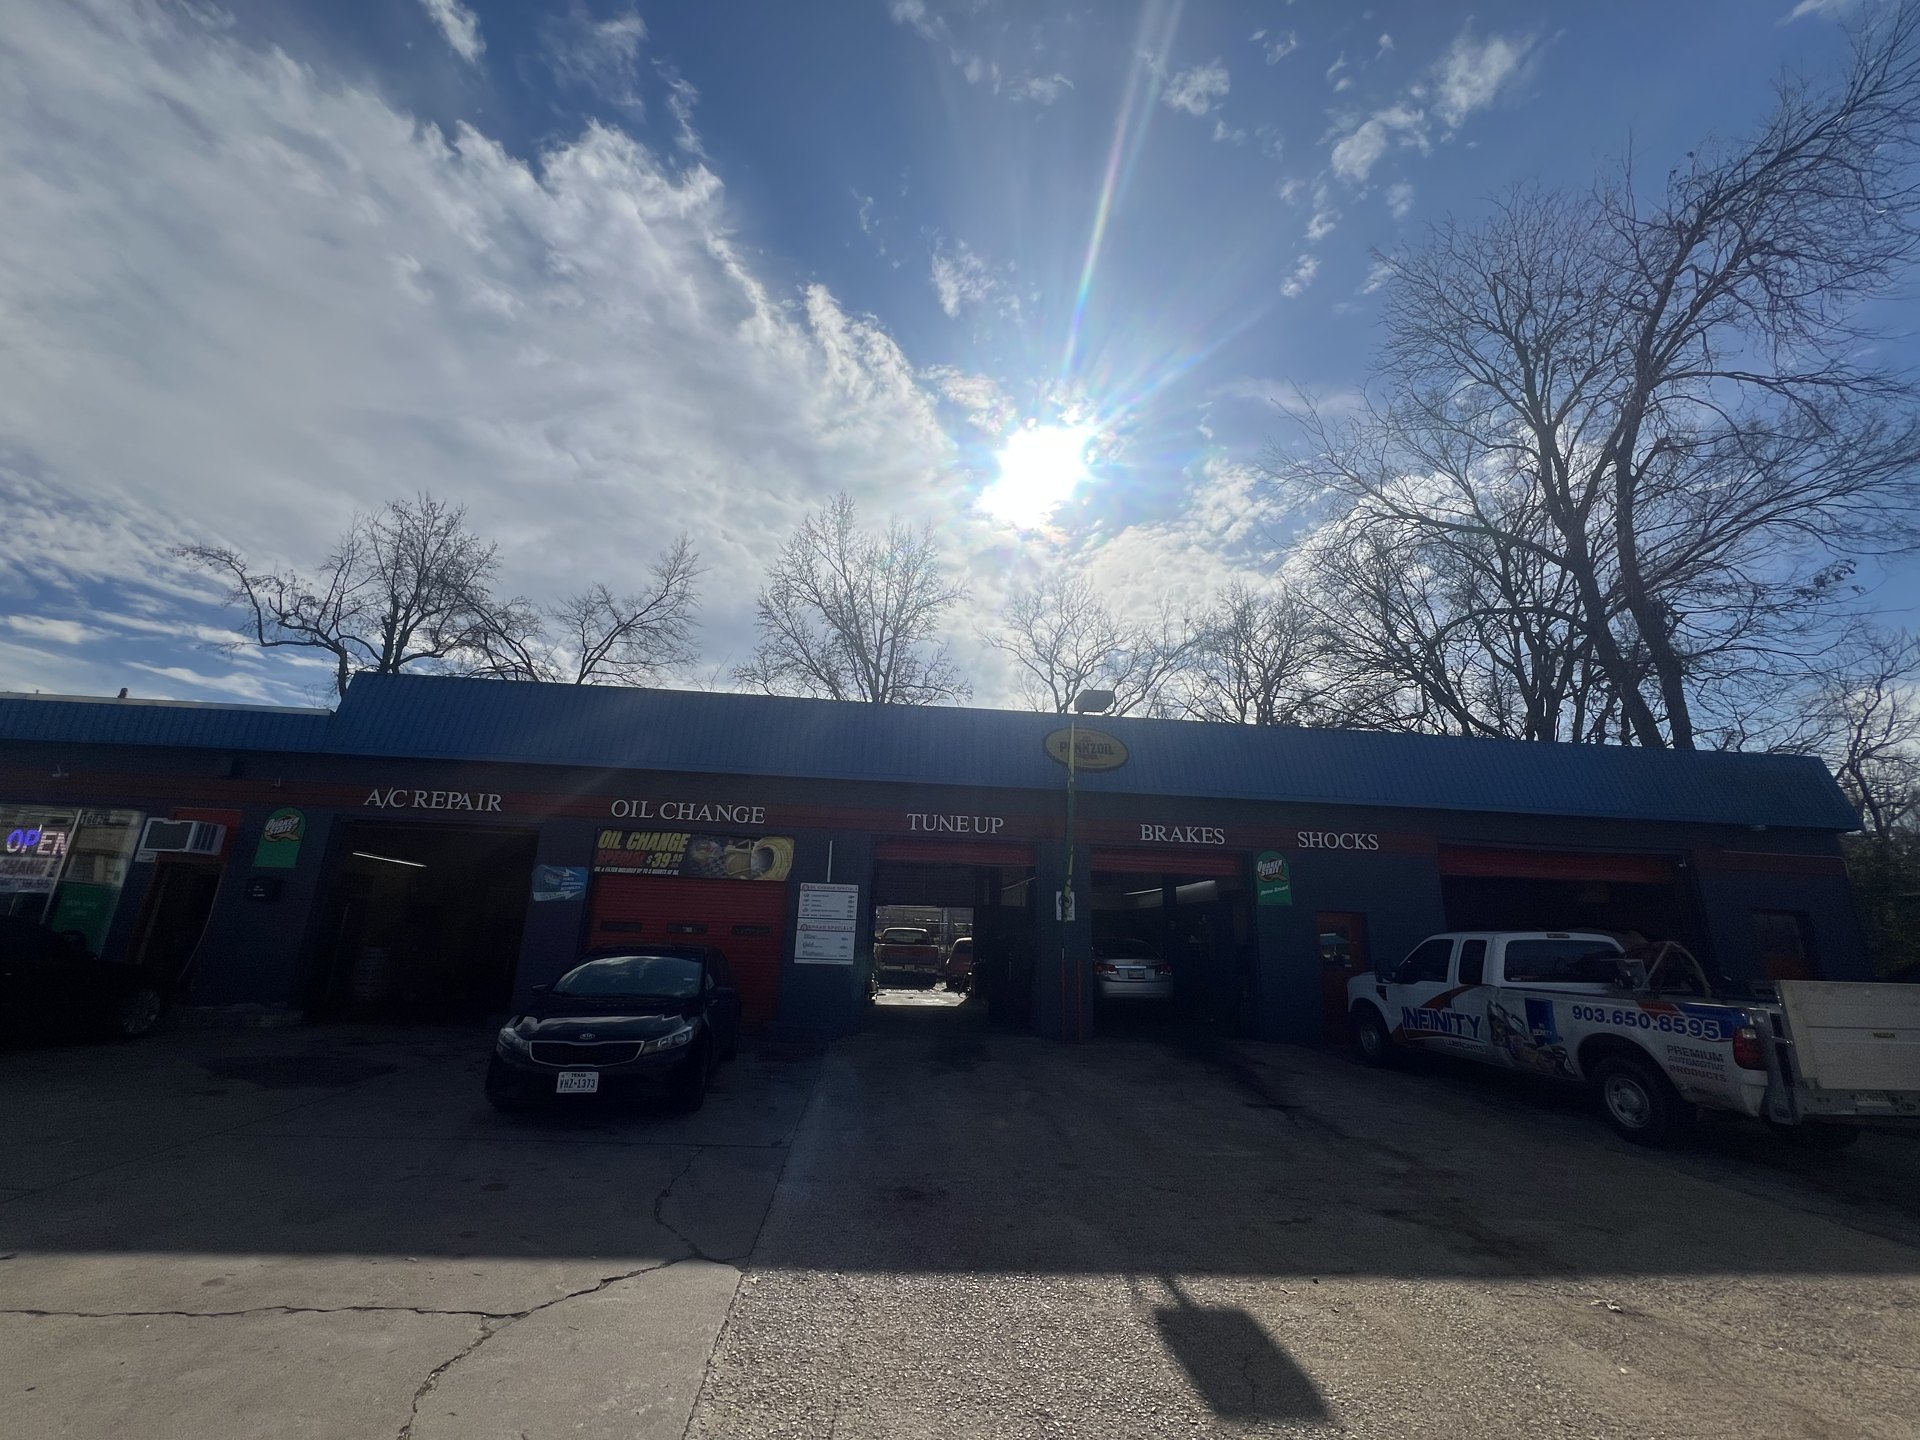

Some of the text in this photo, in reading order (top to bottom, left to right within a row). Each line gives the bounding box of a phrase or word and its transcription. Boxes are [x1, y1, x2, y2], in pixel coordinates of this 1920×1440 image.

[1059, 741, 1114, 756] PNNZOIL
[363, 788, 503, 812] A/C REPAIR
[610, 799, 766, 825] OIL CHANGE
[906, 812, 1005, 835] TUNE UP
[6, 828, 68, 855] OPEN
[597, 830, 691, 853] OIL CHANGE
[1139, 823, 1226, 846] BRAKES
[1297, 831, 1380, 852] SHOCKS
[1257, 859, 1283, 873] QUAKER
[1401, 1005, 1482, 1040] INFINITY
[1571, 1005, 1721, 1040] 903.650.8595
[1667, 1044, 1725, 1063] PREMIUM
[1667, 1055, 1726, 1072] AUTOMOTIVE
[1669, 1064, 1729, 1083] PRODUCTS
